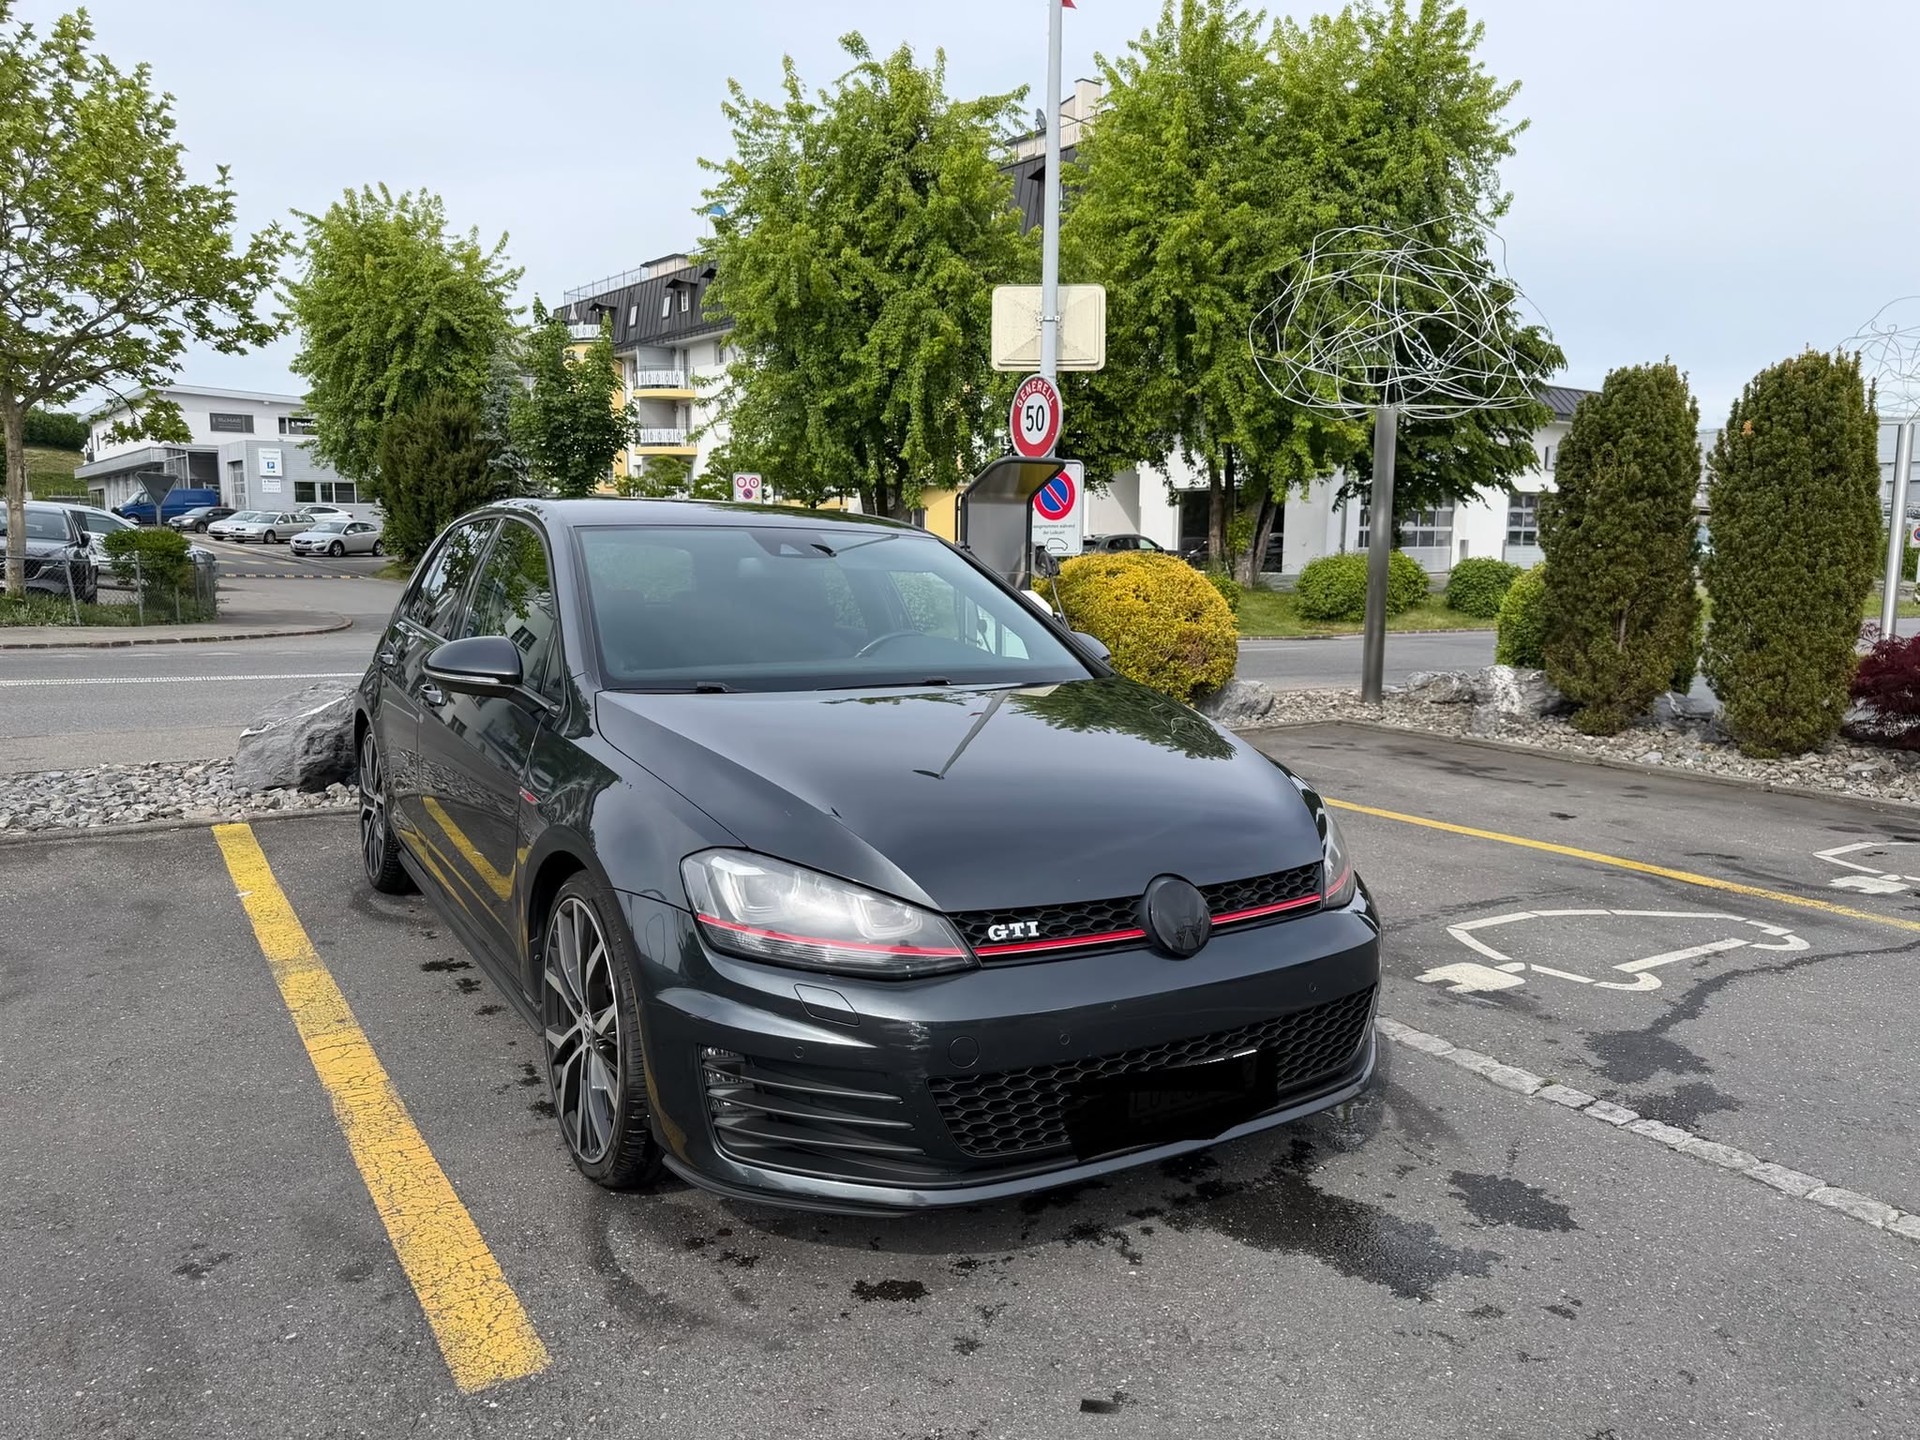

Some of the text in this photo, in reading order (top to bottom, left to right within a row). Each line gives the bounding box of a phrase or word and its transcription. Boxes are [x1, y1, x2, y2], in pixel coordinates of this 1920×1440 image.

[1016, 380, 1055, 408] GENERELL
[1026, 404, 1045, 432] 50
[988, 921, 1040, 941] GTI
